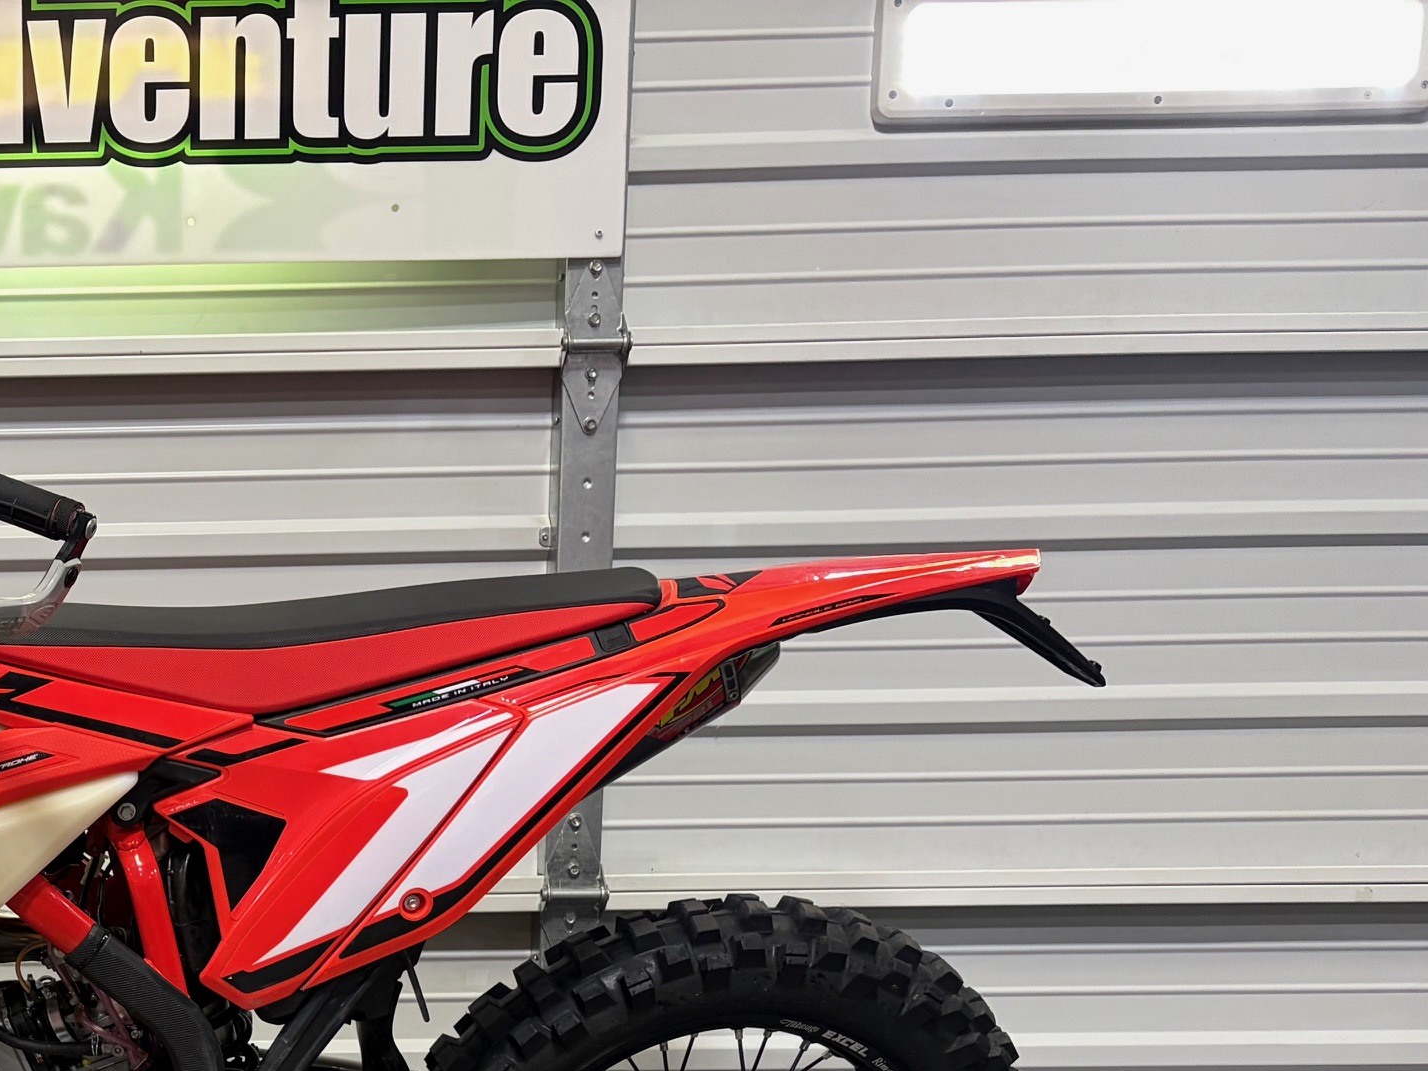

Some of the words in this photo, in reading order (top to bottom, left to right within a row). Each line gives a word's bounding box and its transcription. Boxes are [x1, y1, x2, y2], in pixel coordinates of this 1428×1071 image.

[411, 693, 450, 709] MADE
[453, 687, 467, 697] IN
[470, 675, 509, 692] ITALY
[820, 1029, 870, 1058] EXCEL
